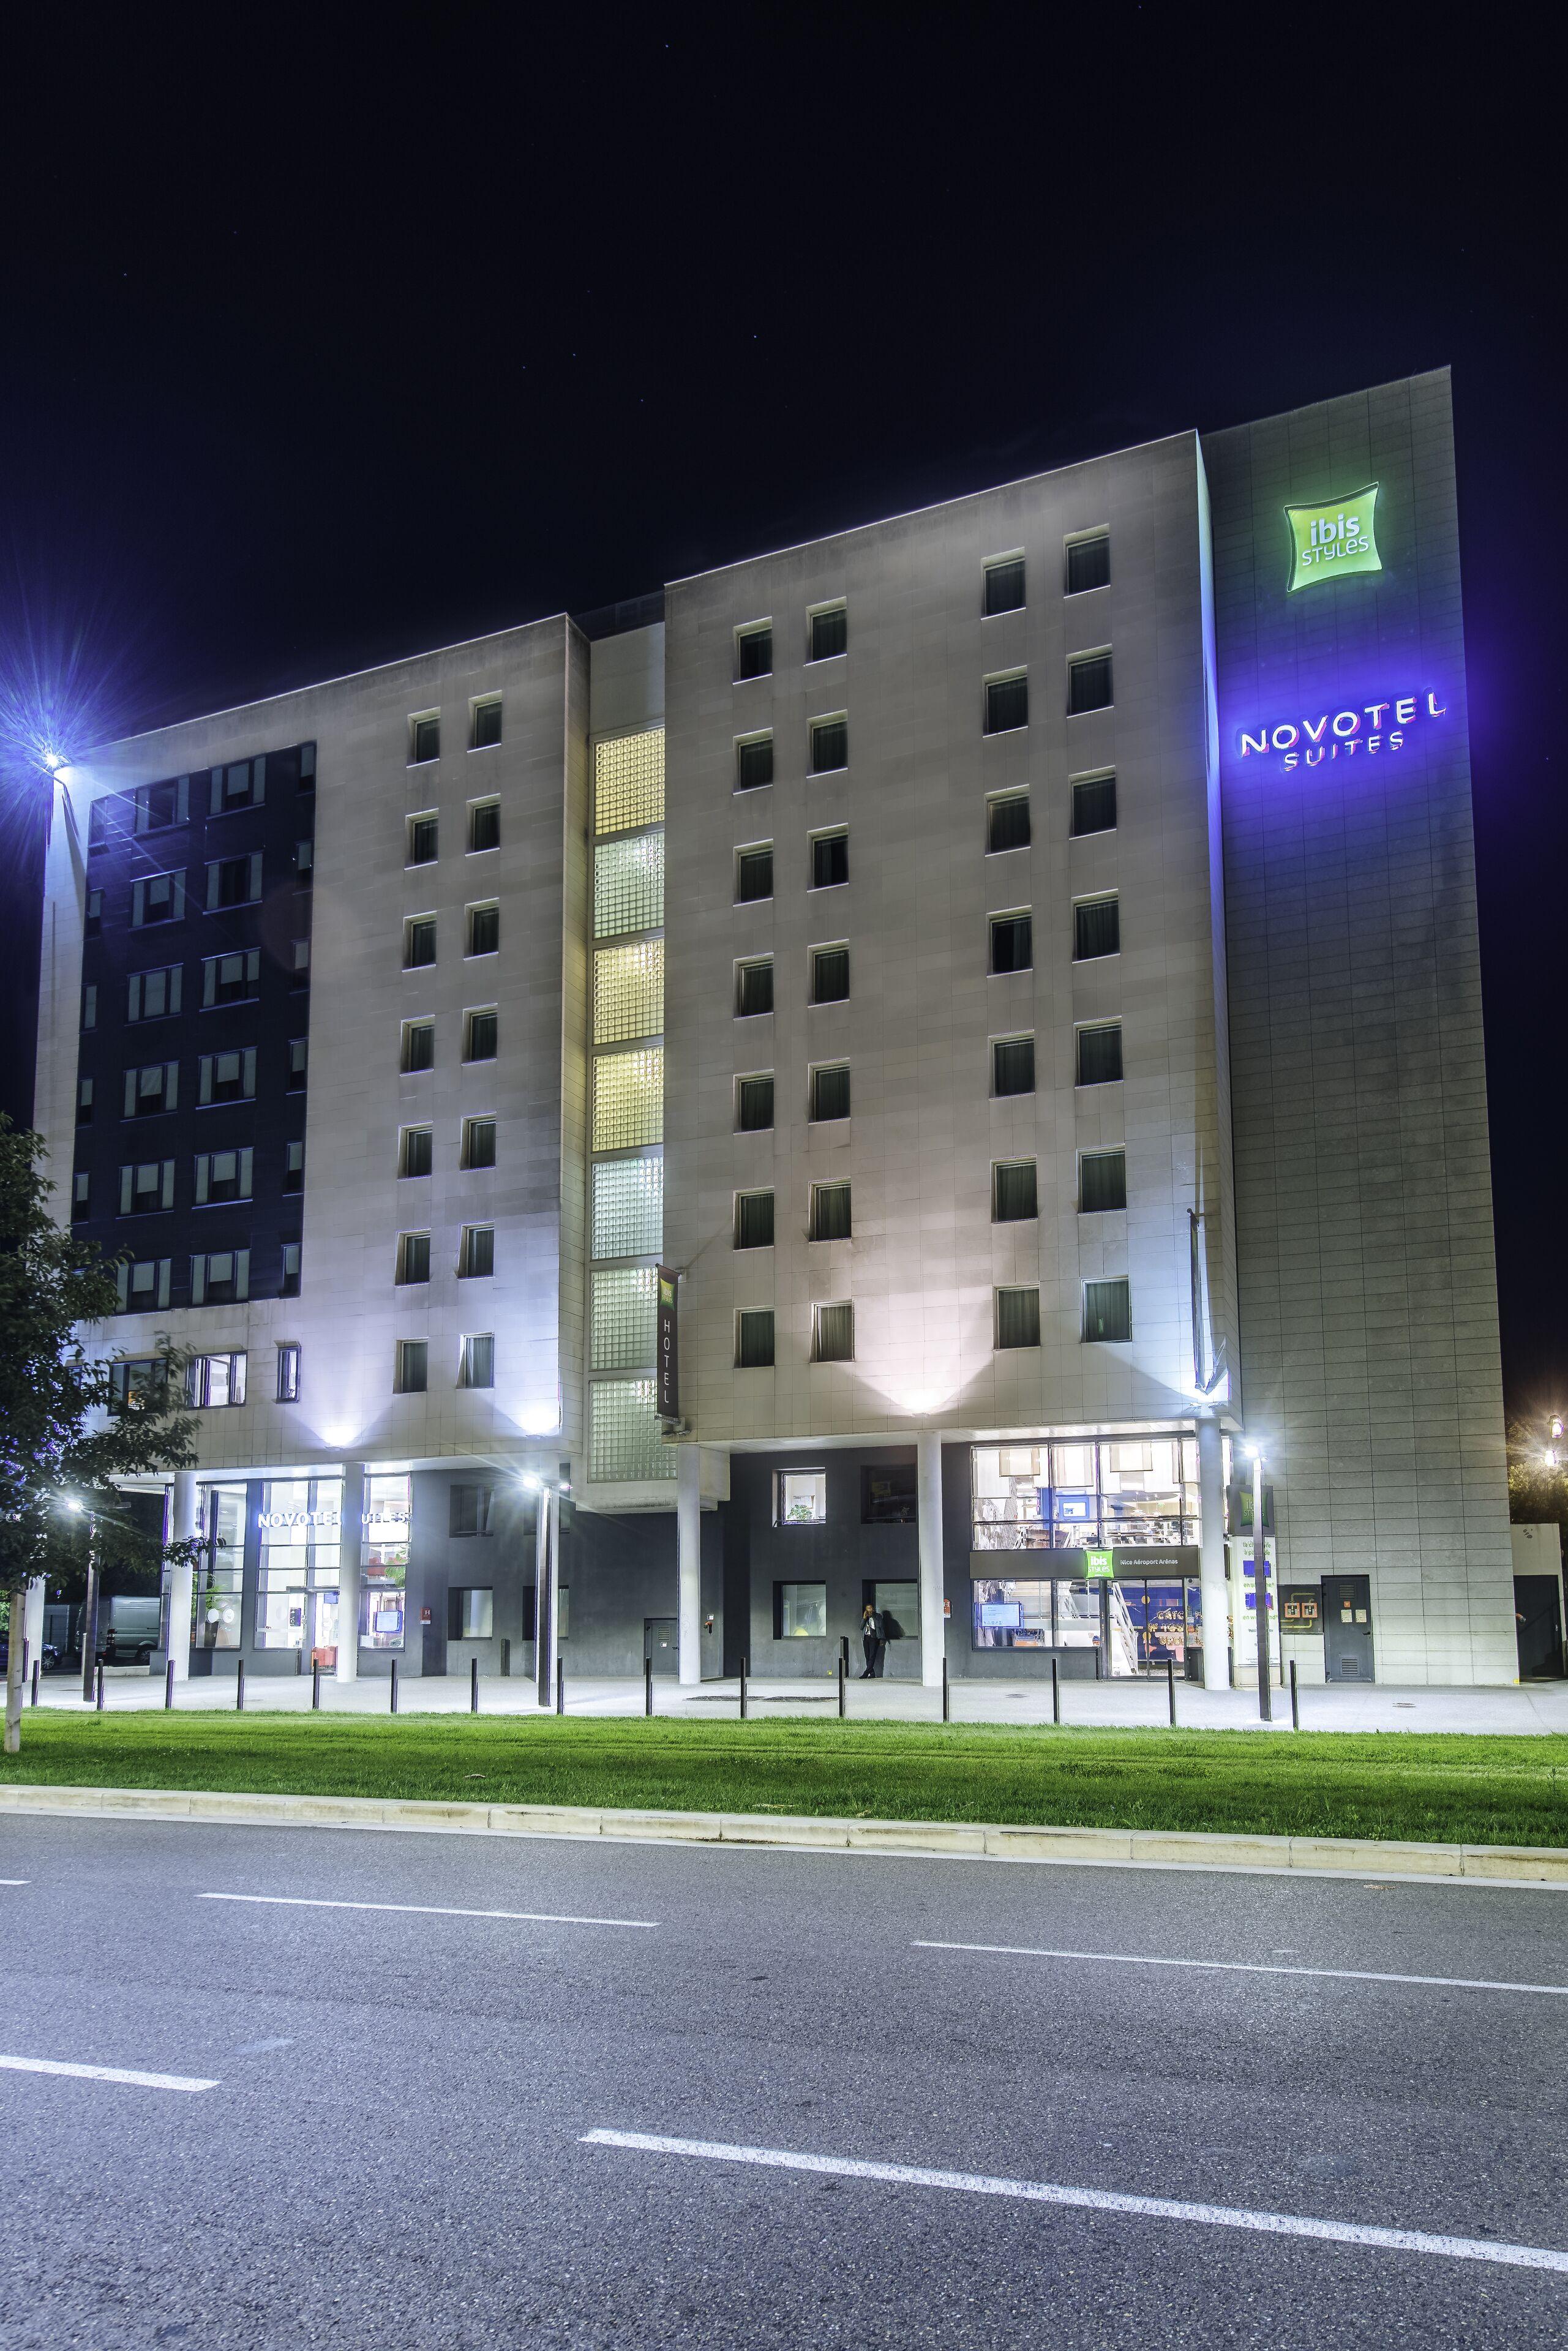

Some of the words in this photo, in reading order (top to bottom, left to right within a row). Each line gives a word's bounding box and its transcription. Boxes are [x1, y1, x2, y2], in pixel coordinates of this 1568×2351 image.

[1310, 513, 1360, 547] ibis
[1241, 691, 1447, 758] NOVOTEL
[1284, 730, 1405, 772] SUITES
[1090, 1556, 1108, 1565] ibis
